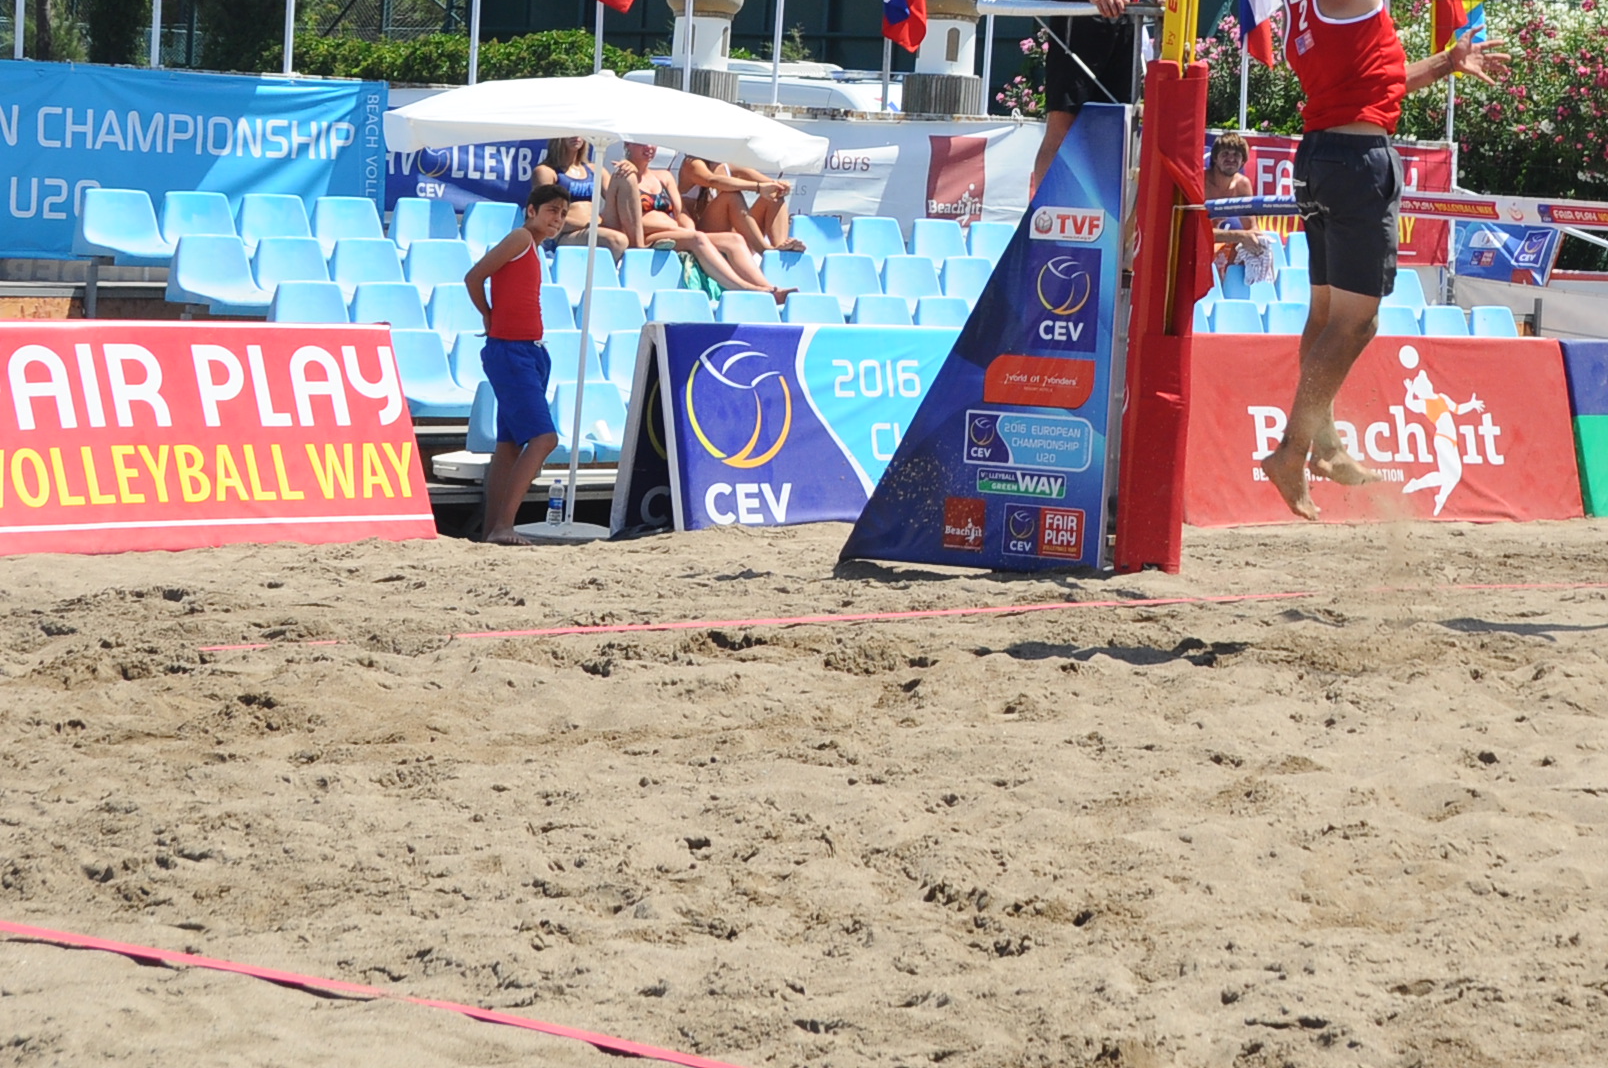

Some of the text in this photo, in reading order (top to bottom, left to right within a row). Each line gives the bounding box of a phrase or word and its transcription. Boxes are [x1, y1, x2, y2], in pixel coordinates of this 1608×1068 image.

[1298, 0, 1308, 32] 2
[37, 106, 354, 161] CHAMPIONSHIP
[365, 94, 380, 204] BEACH VOLL
[415, 182, 446, 198] CEV
[927, 199, 966, 215] Beach
[1399, 200, 1414, 210] AIR
[1057, 214, 1101, 235] TVF
[1039, 320, 1084, 342] CEV
[831, 359, 921, 398] 2016
[1003, 371, 1028, 385] World
[1042, 373, 1077, 387] Wonders
[8, 343, 402, 431] AIR PLAY
[1004, 422, 1081, 438] 2016 EUROPEAN
[1247, 405, 1504, 465] Bach it
[970, 446, 992, 458] CEV
[1011, 437, 1079, 451] CHAMPIONSHIP
[1036, 453, 1056, 463] U20
[304, 442, 413, 500] WAY
[991, 482, 1017, 491] GREEN
[1016, 470, 1063, 497] WAY
[704, 482, 792, 526] CEV
[944, 525, 970, 536] Beach
[1045, 514, 1078, 531] FAIR
[1009, 540, 1032, 551] CEV
[1044, 531, 1077, 546] PLAY
